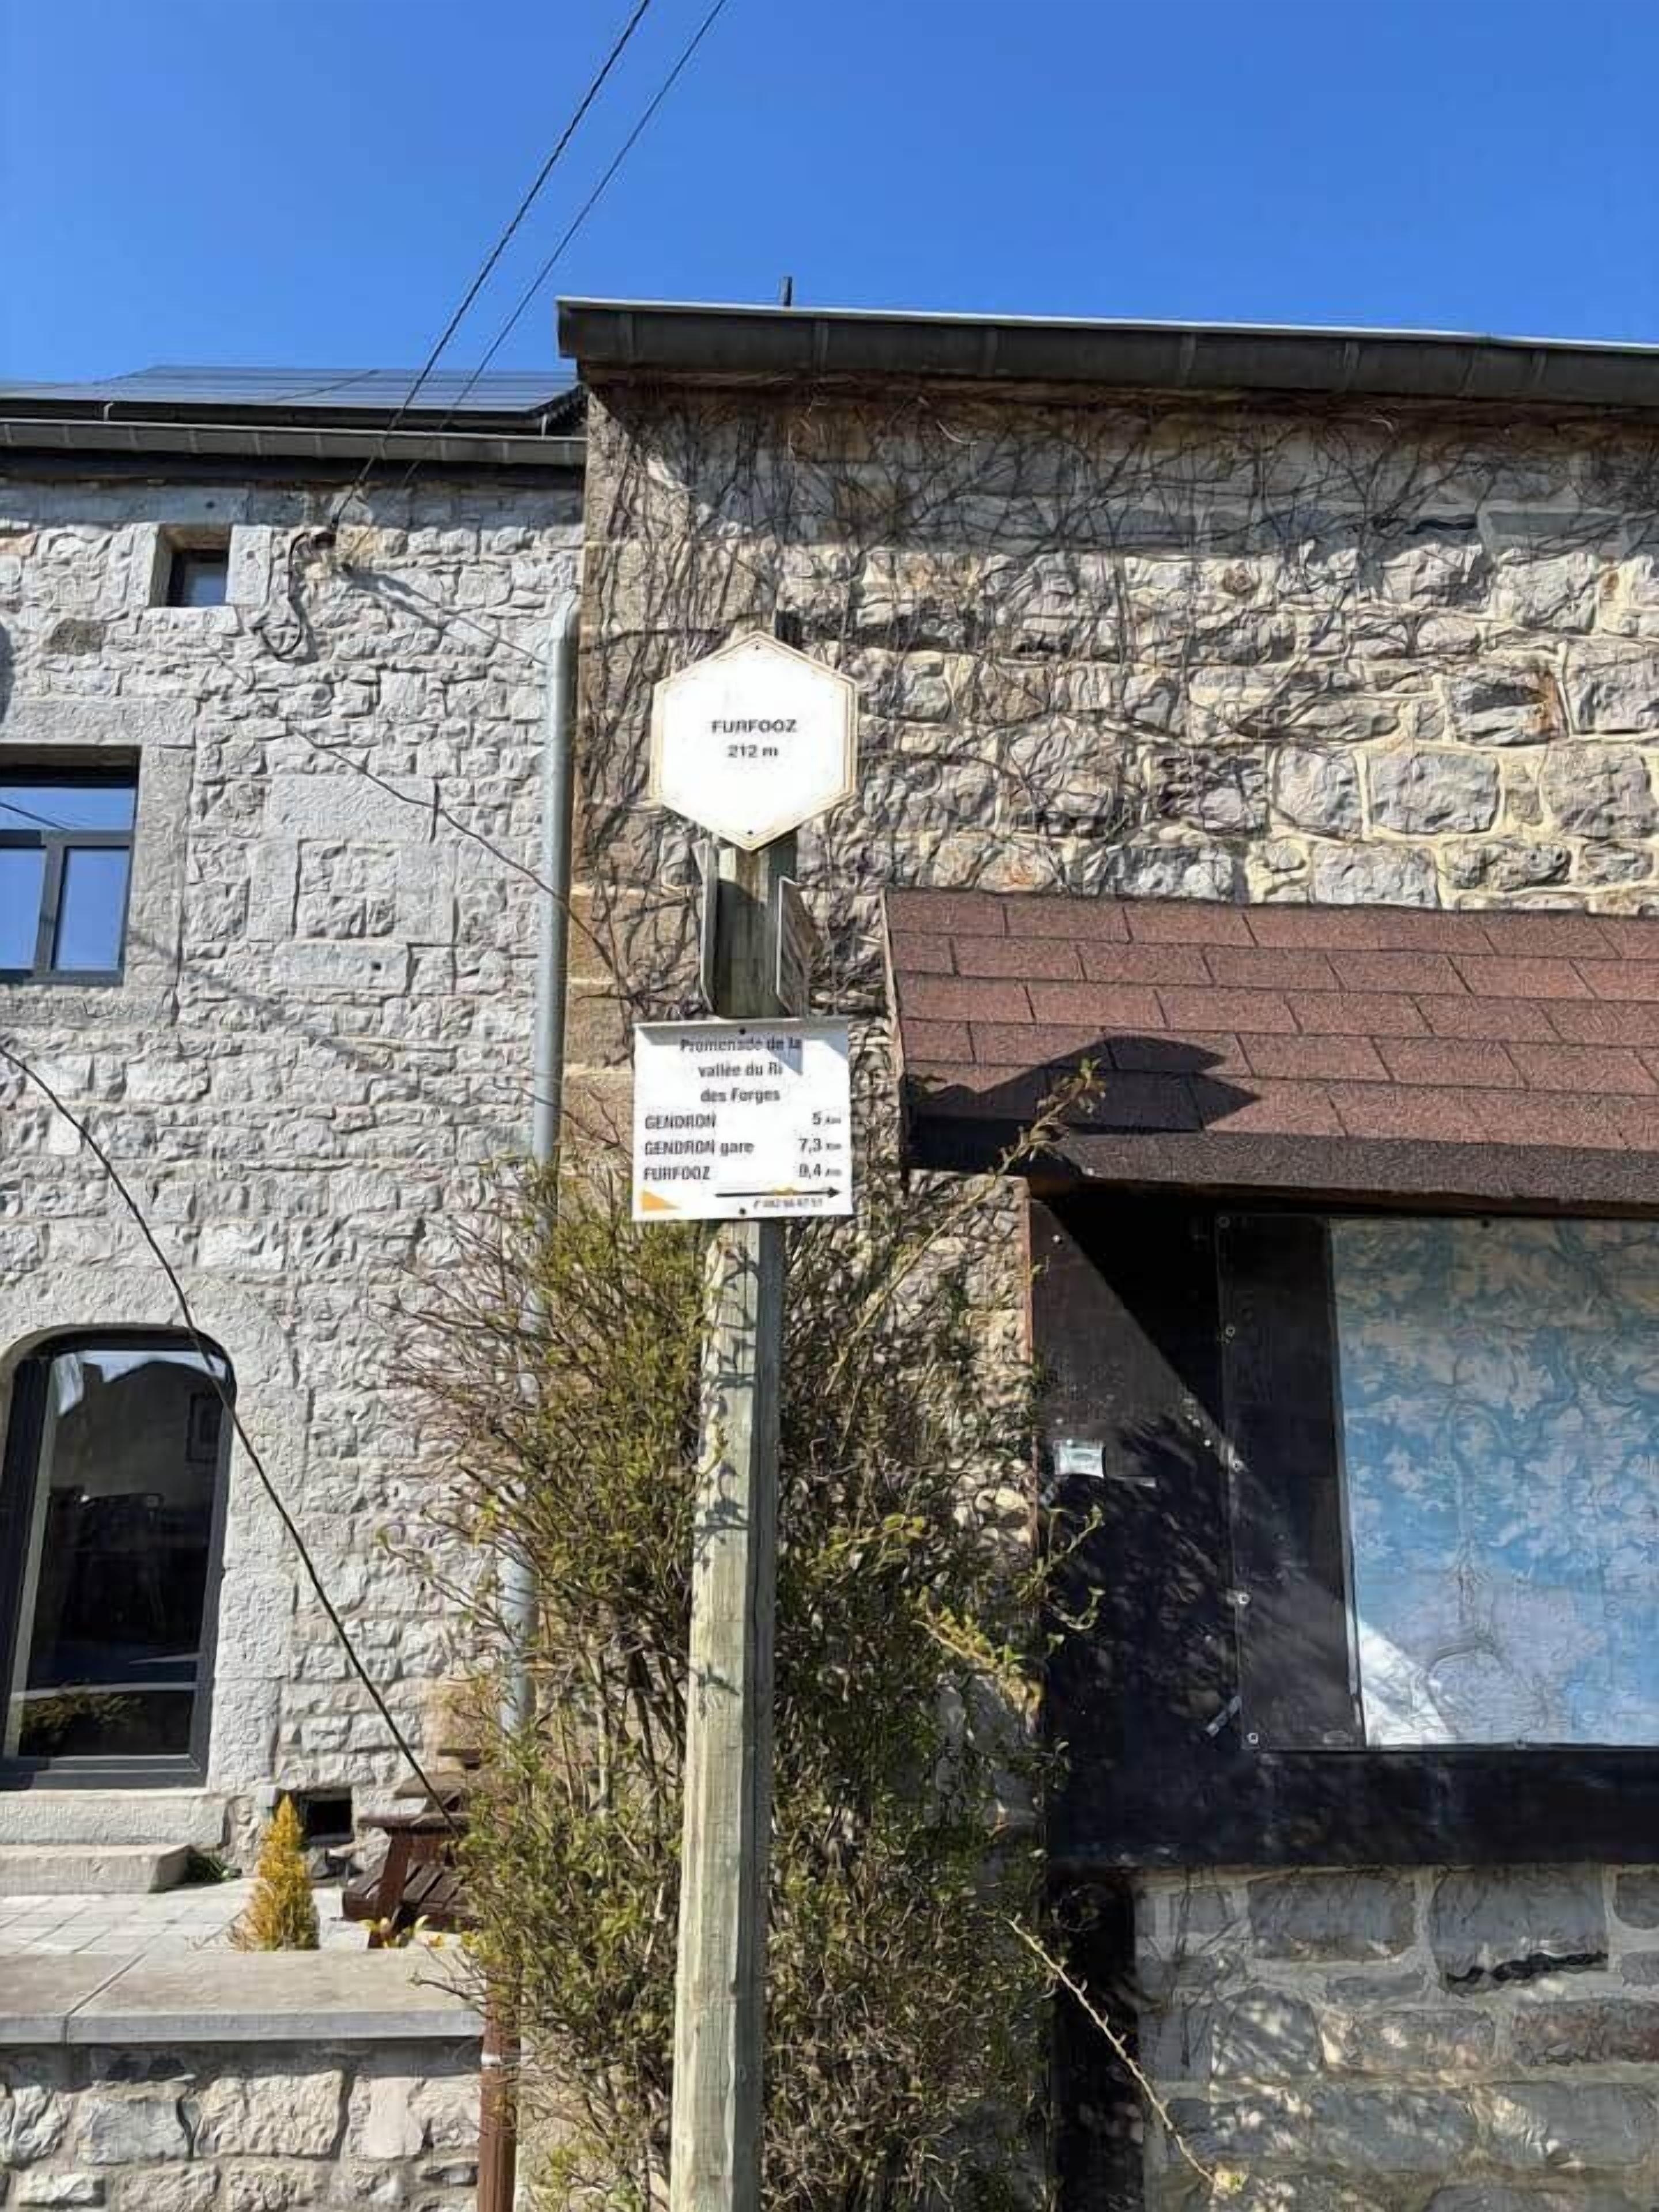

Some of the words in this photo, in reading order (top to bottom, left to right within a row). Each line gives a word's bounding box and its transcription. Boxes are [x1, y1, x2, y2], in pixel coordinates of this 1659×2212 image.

[711, 719, 797, 733] FURFOOZ
[728, 744, 757, 758] 212
[762, 747, 778, 756] m
[746, 1061, 763, 1076] du
[700, 1089, 726, 1102] des
[731, 1088, 781, 1105] Forges
[645, 1113, 716, 1129] GENDRON
[813, 1111, 821, 1125] 5
[645, 1139, 715, 1155] GENDRON
[721, 1142, 755, 1157] gare
[644, 1165, 710, 1180] FURFOOZ
